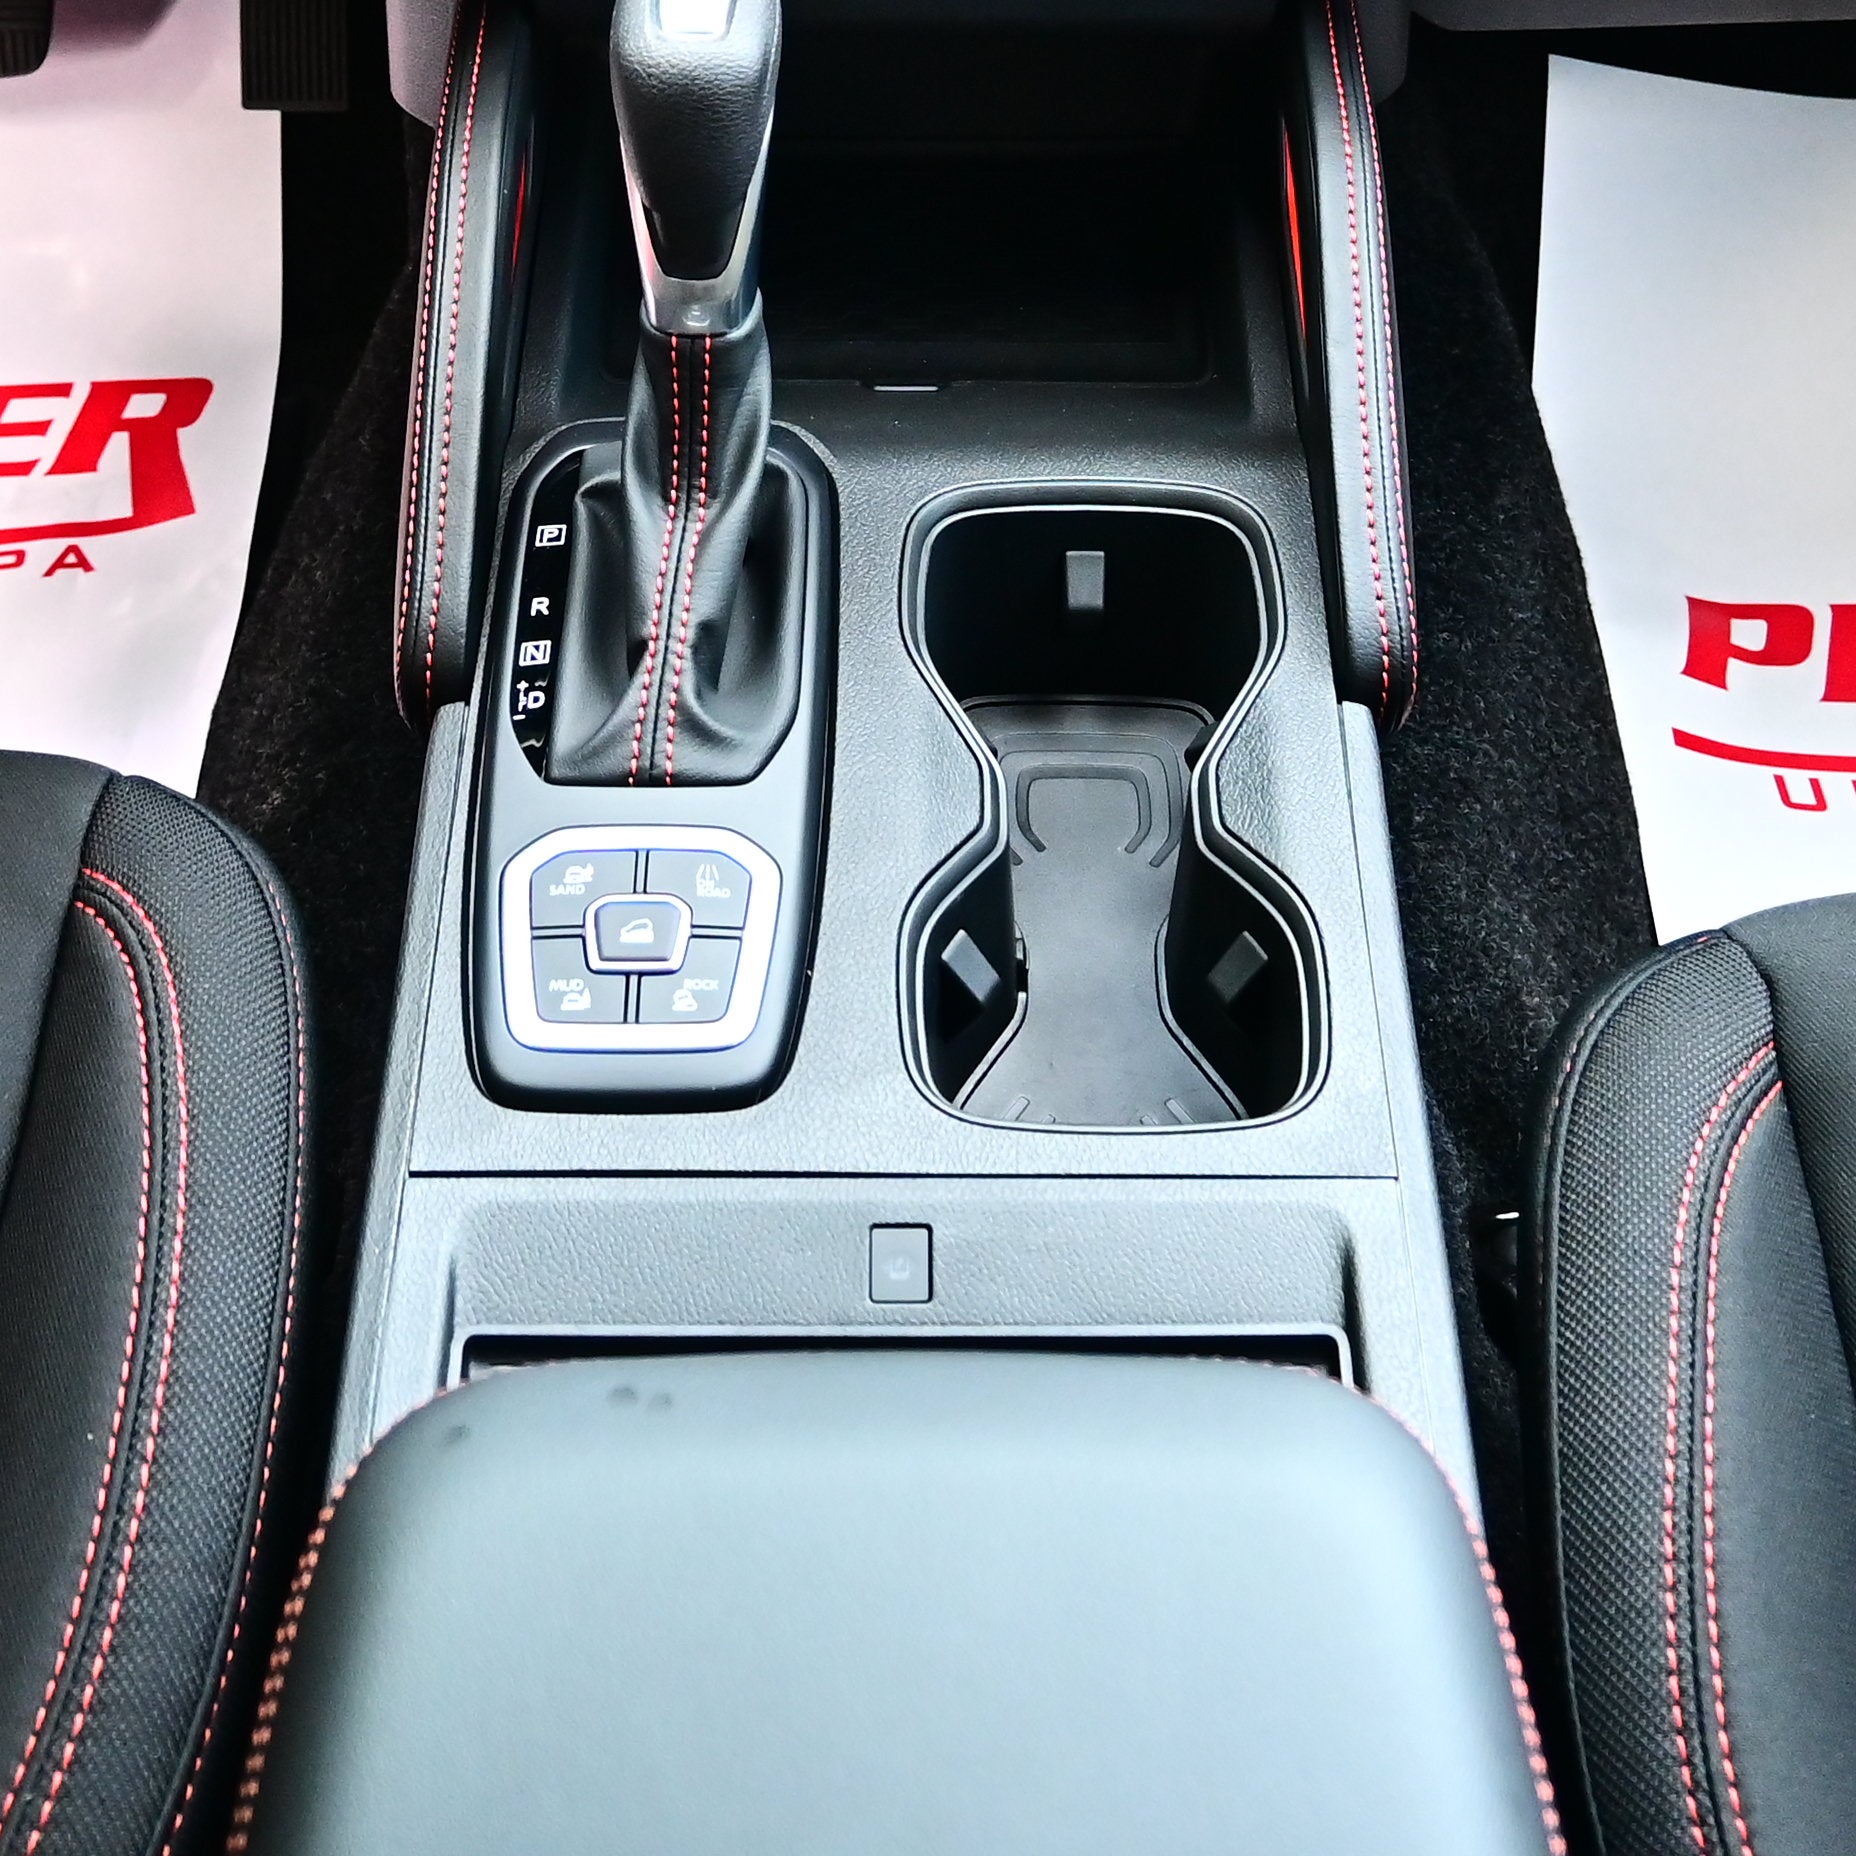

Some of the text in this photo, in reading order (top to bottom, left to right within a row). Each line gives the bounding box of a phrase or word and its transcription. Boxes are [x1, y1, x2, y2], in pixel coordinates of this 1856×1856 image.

[530, 597, 550, 616] R
[549, 884, 585, 896] SAND
[697, 887, 731, 898] ROAD
[549, 978, 584, 992] MUD
[683, 979, 719, 991] ROCK
